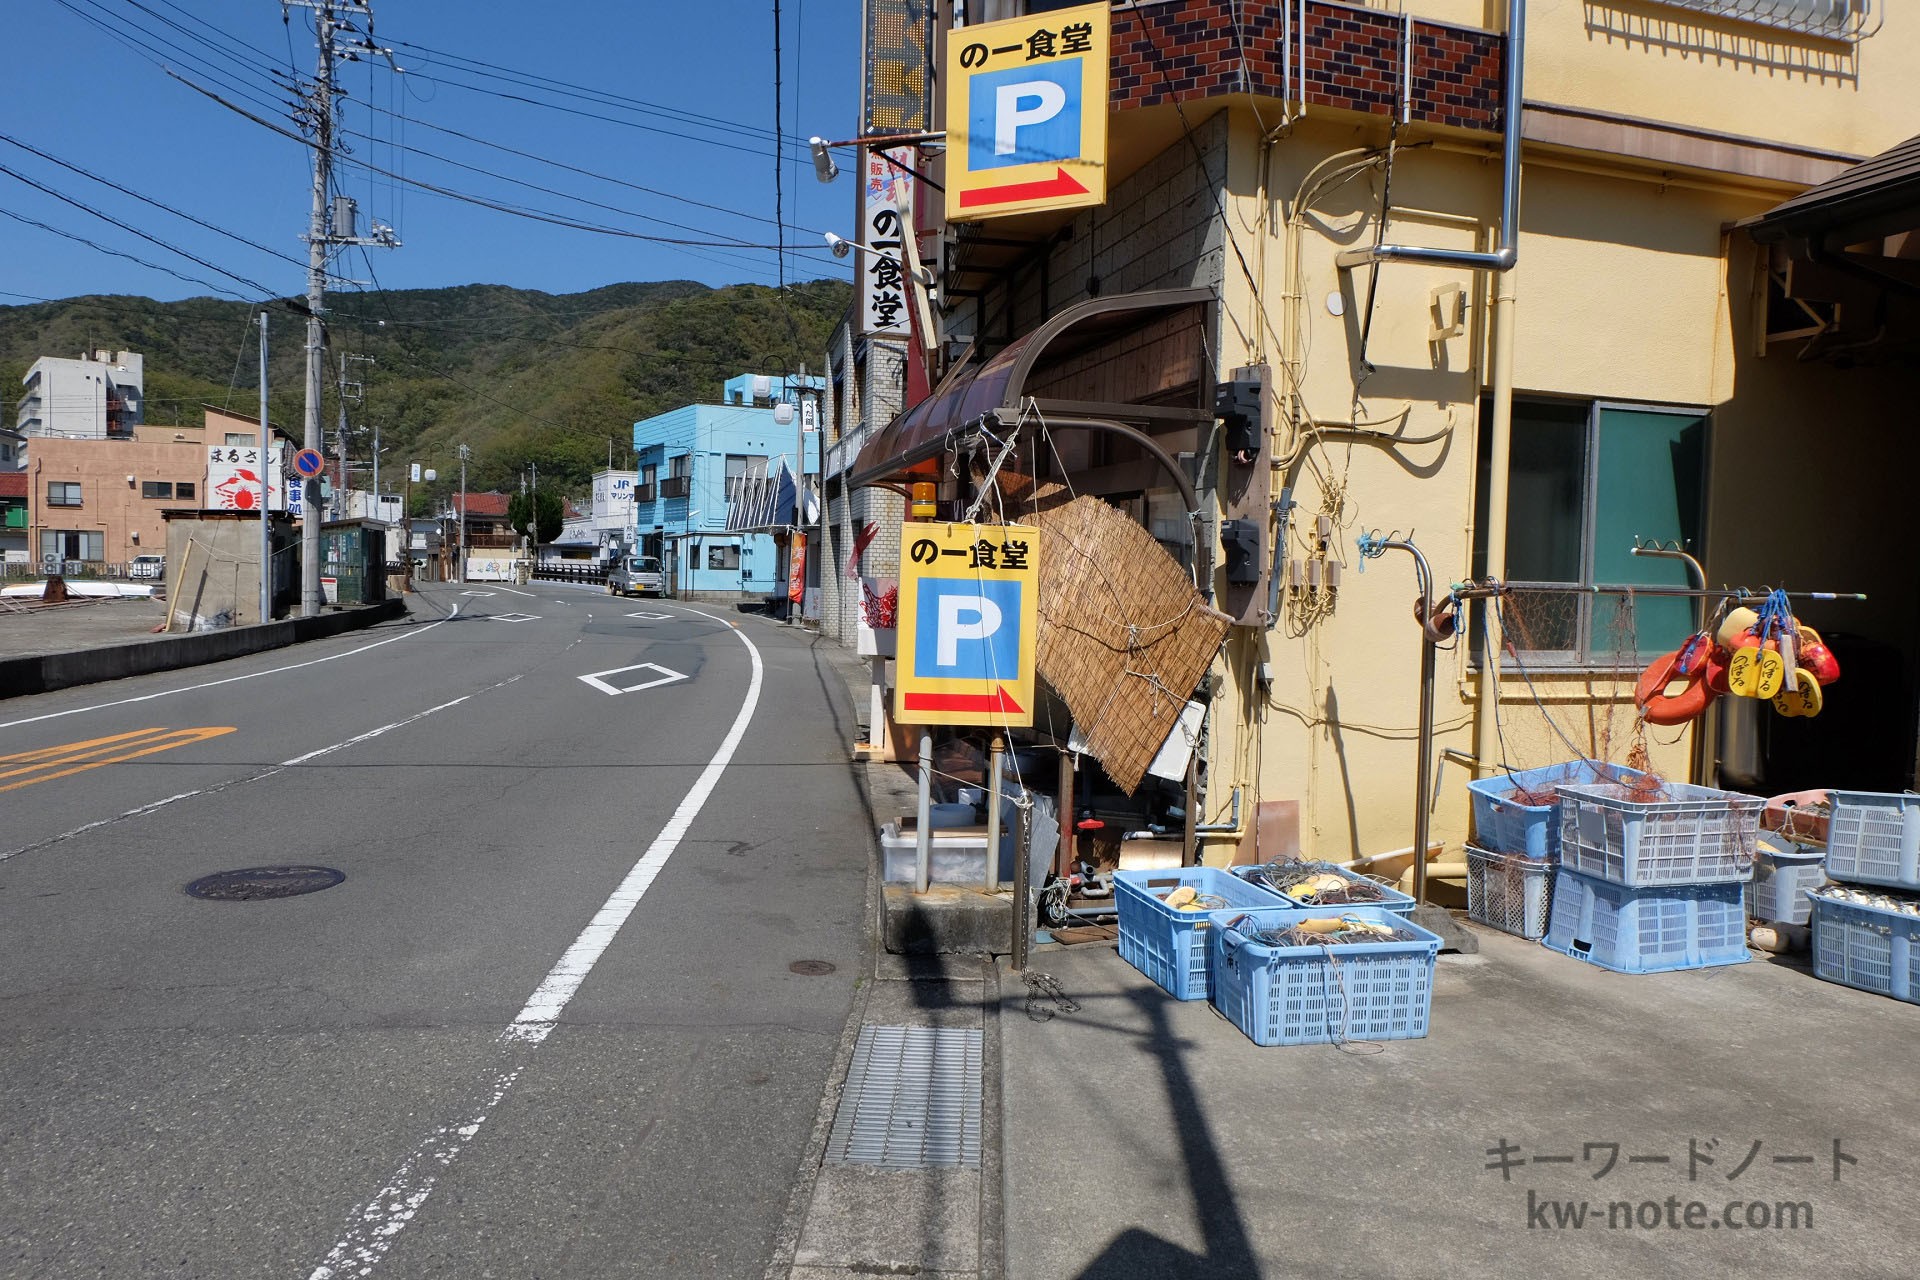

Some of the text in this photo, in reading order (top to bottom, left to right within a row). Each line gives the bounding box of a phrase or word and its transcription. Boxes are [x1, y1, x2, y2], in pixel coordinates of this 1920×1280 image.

[960, 22, 1092, 68] の一食堂
[994, 80, 1066, 156] P
[870, 209, 902, 328] の一食堂
[911, 538, 1029, 570] の一食堂
[936, 594, 1003, 667] P
